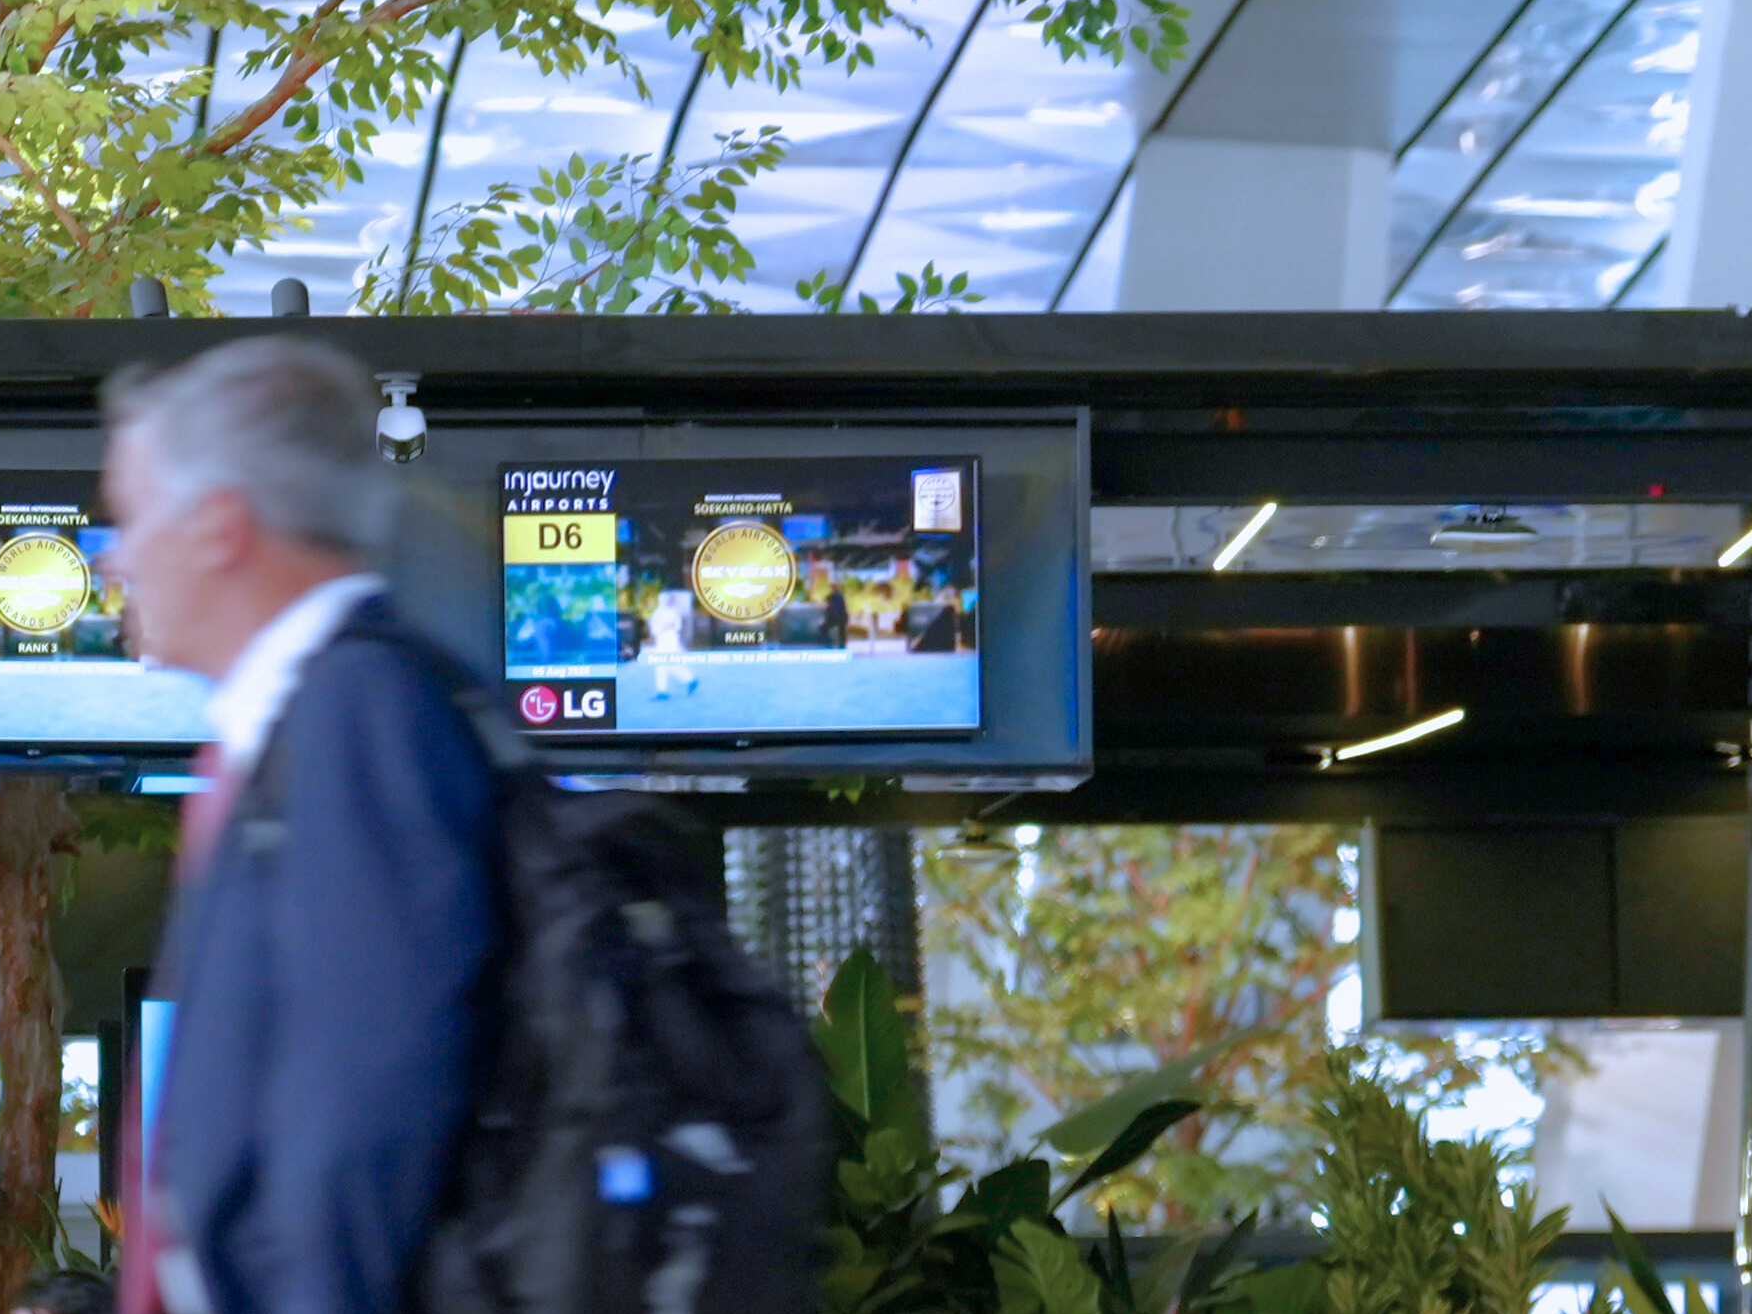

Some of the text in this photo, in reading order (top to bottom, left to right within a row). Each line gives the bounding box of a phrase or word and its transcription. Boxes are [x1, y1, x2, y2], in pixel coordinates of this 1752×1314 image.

[504, 470, 614, 497] injourney
[507, 498, 609, 511] AIRPORTS
[694, 502, 793, 515] SOEKARNO-HATTA
[539, 522, 583, 550] D6
[36, 540, 80, 571] AIRPORT
[18, 643, 58, 653] RANK 3
[725, 632, 765, 644] RANK 3
[563, 690, 605, 718] LG
